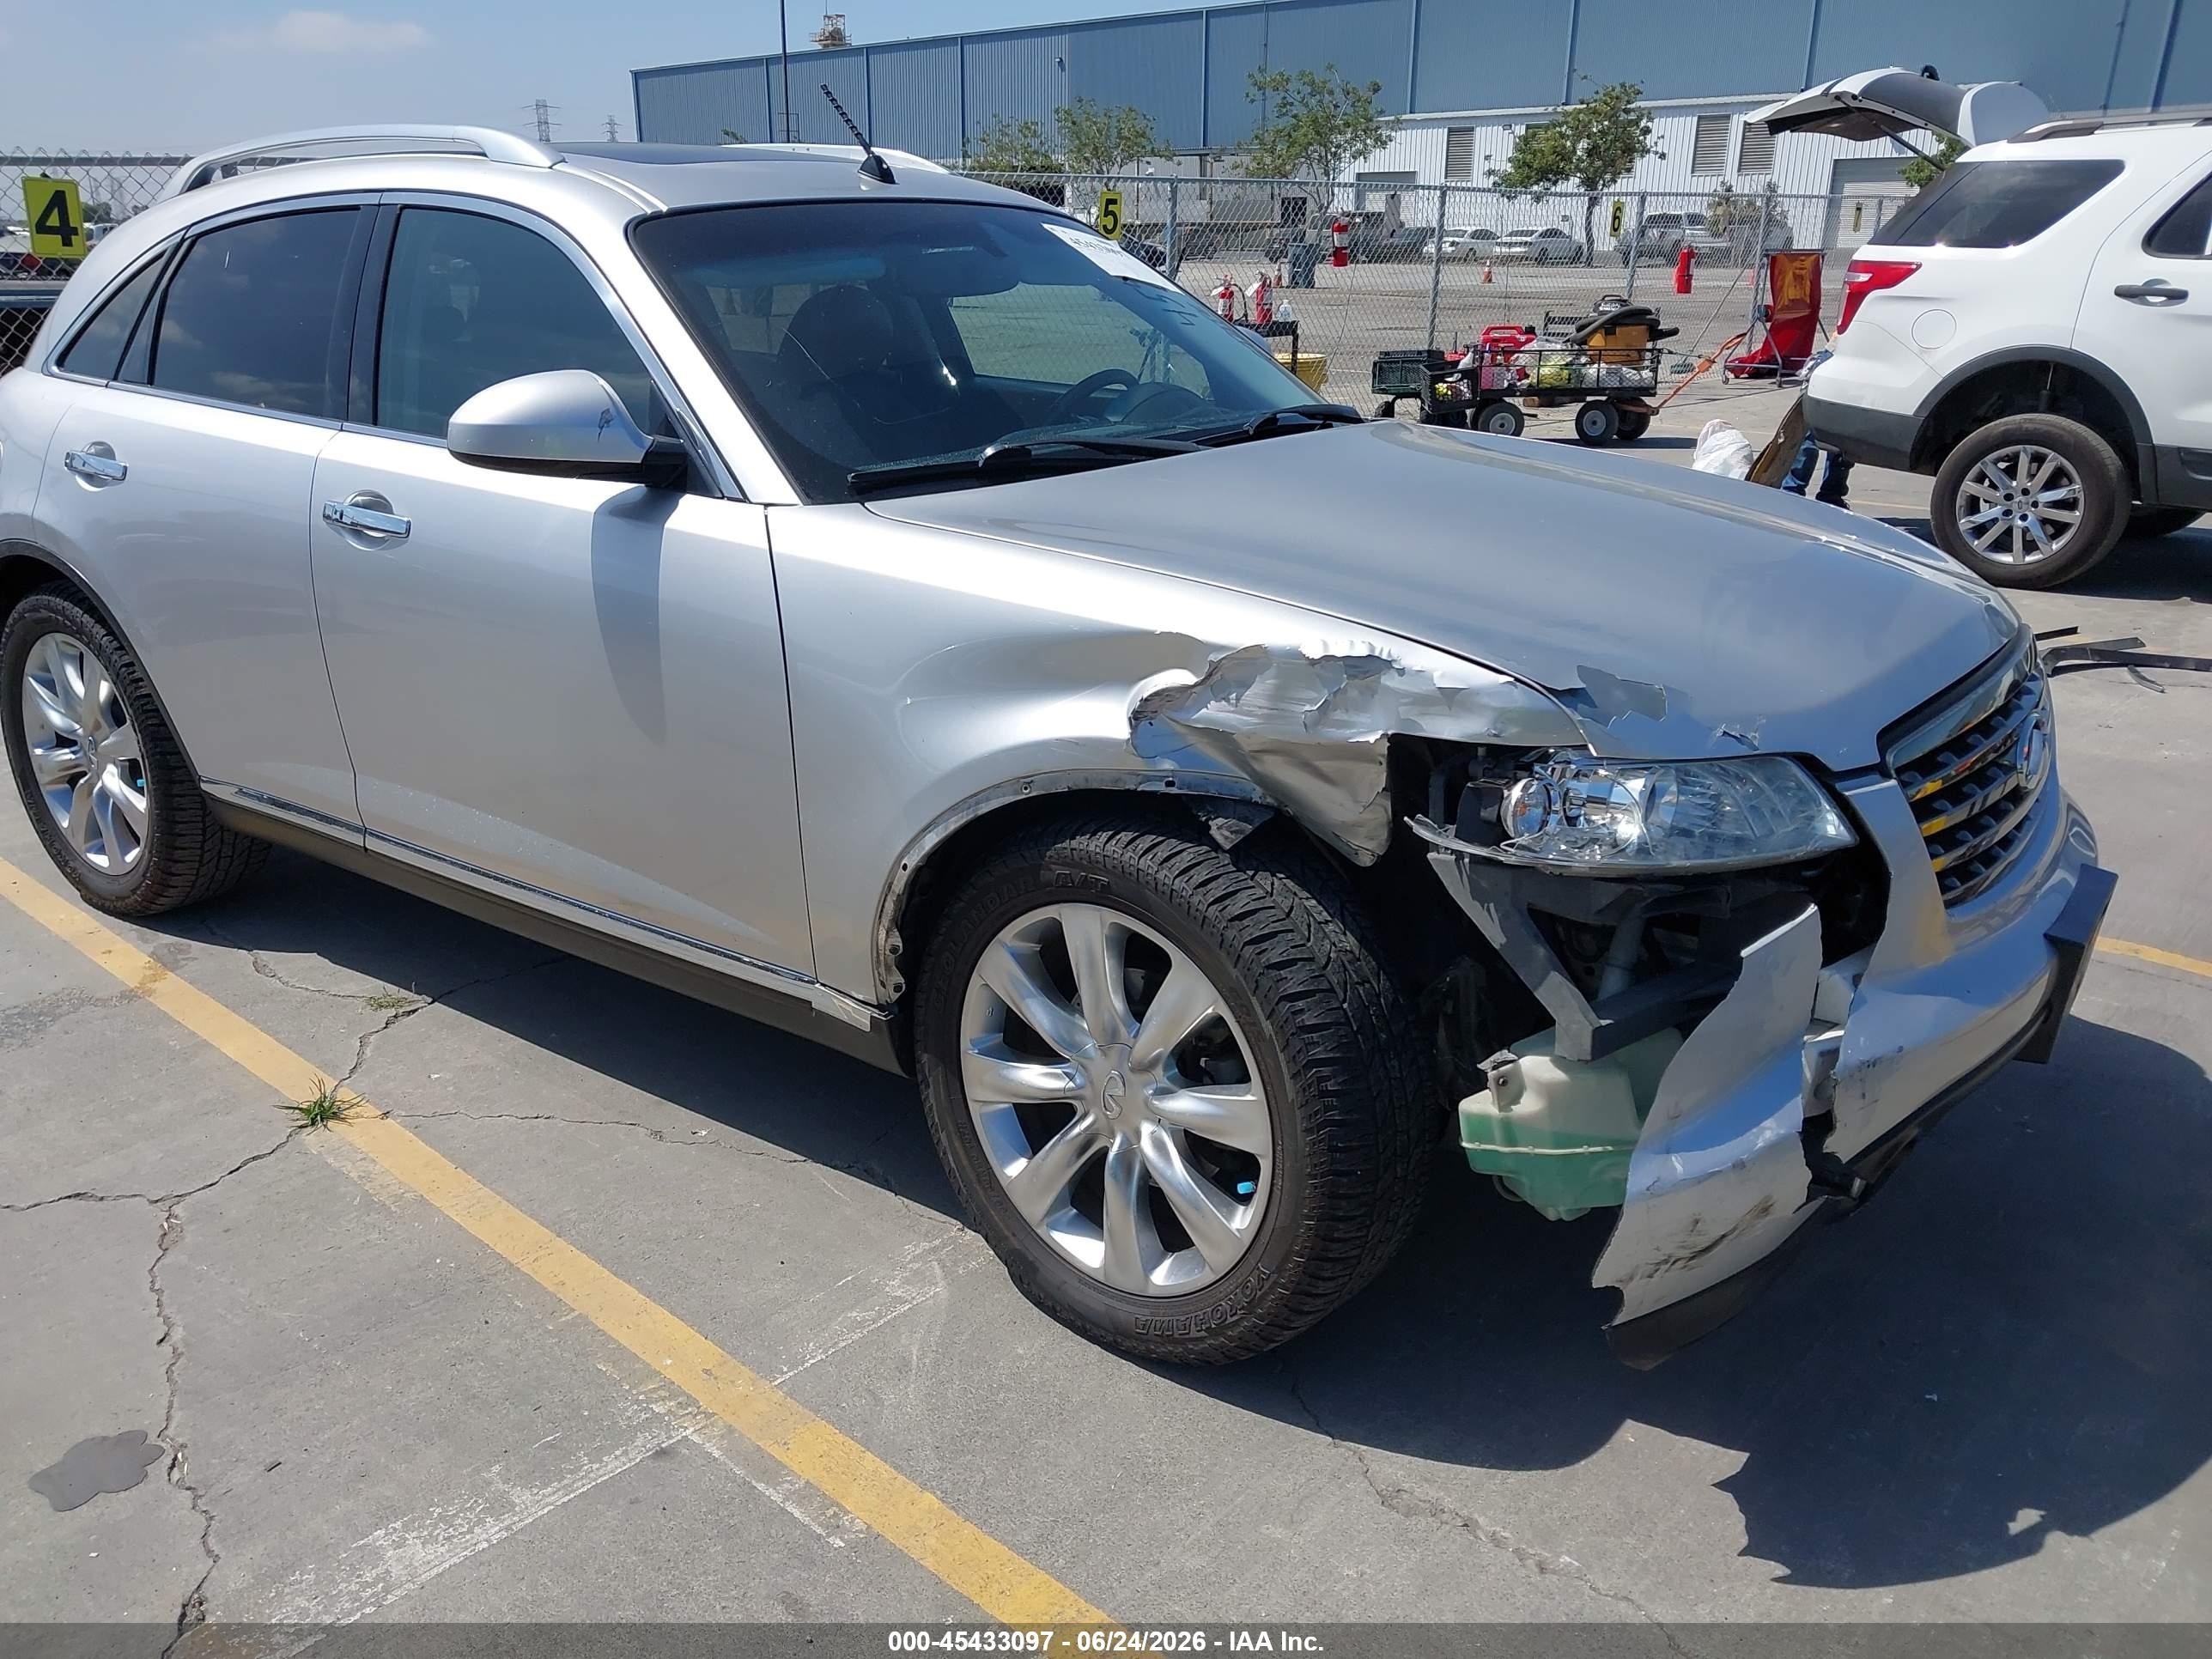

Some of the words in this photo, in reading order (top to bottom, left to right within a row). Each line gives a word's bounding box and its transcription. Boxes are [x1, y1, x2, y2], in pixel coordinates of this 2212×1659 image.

[34, 189, 80, 248] 4
[1102, 198, 1120, 235] 5
[1612, 206, 1622, 233] 6
[1054, 869, 1112, 894] A/T
[1133, 1262, 1272, 1336] YOKOHAMA
